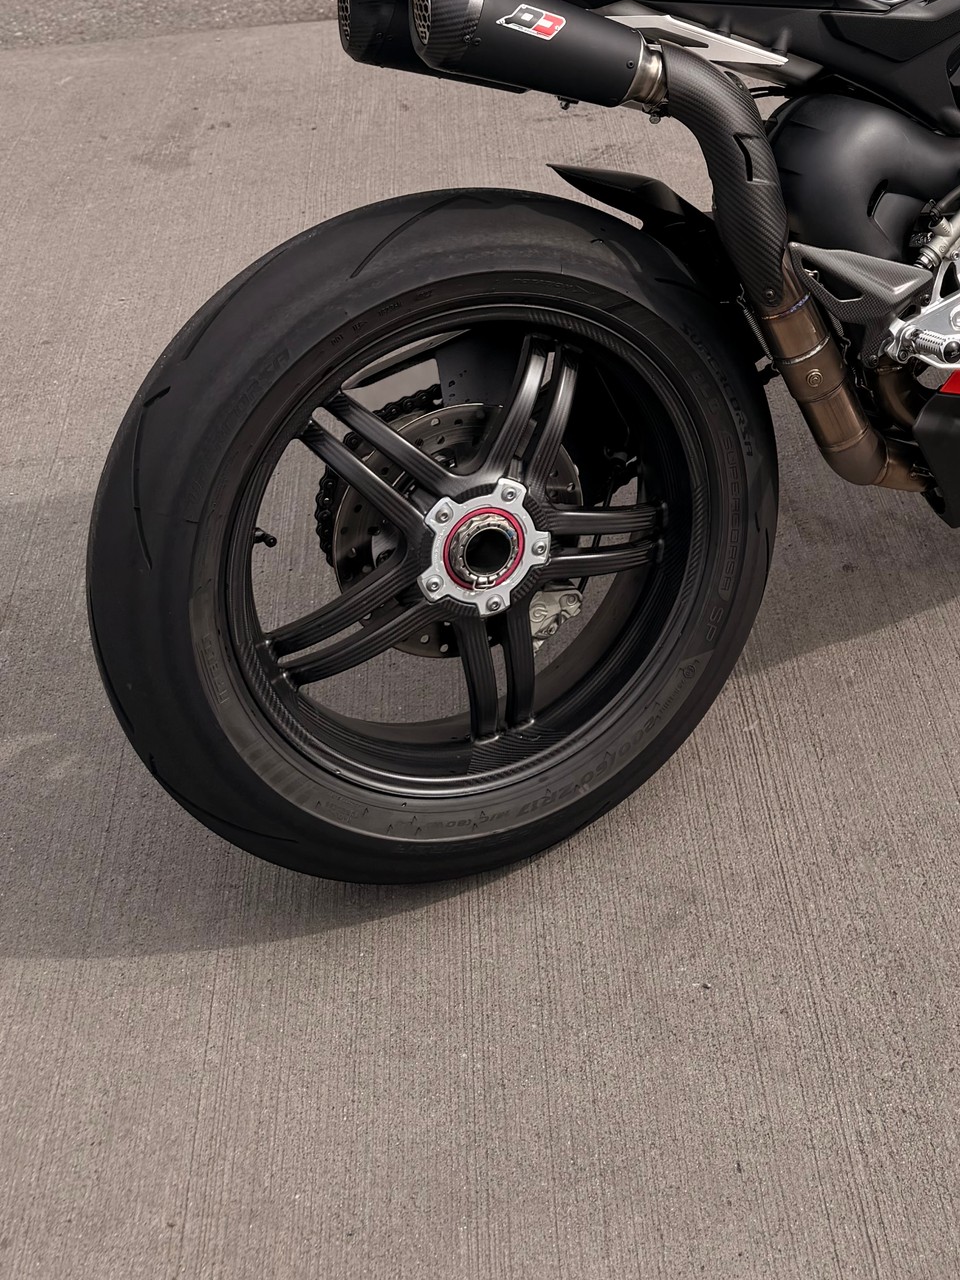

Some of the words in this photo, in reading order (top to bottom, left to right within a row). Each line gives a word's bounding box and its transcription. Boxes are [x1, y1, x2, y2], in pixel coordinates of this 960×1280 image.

[677, 320, 753, 459] SUPERCORSA
[715, 430, 745, 593] SUPERCORSA
[699, 605, 726, 643] SP
